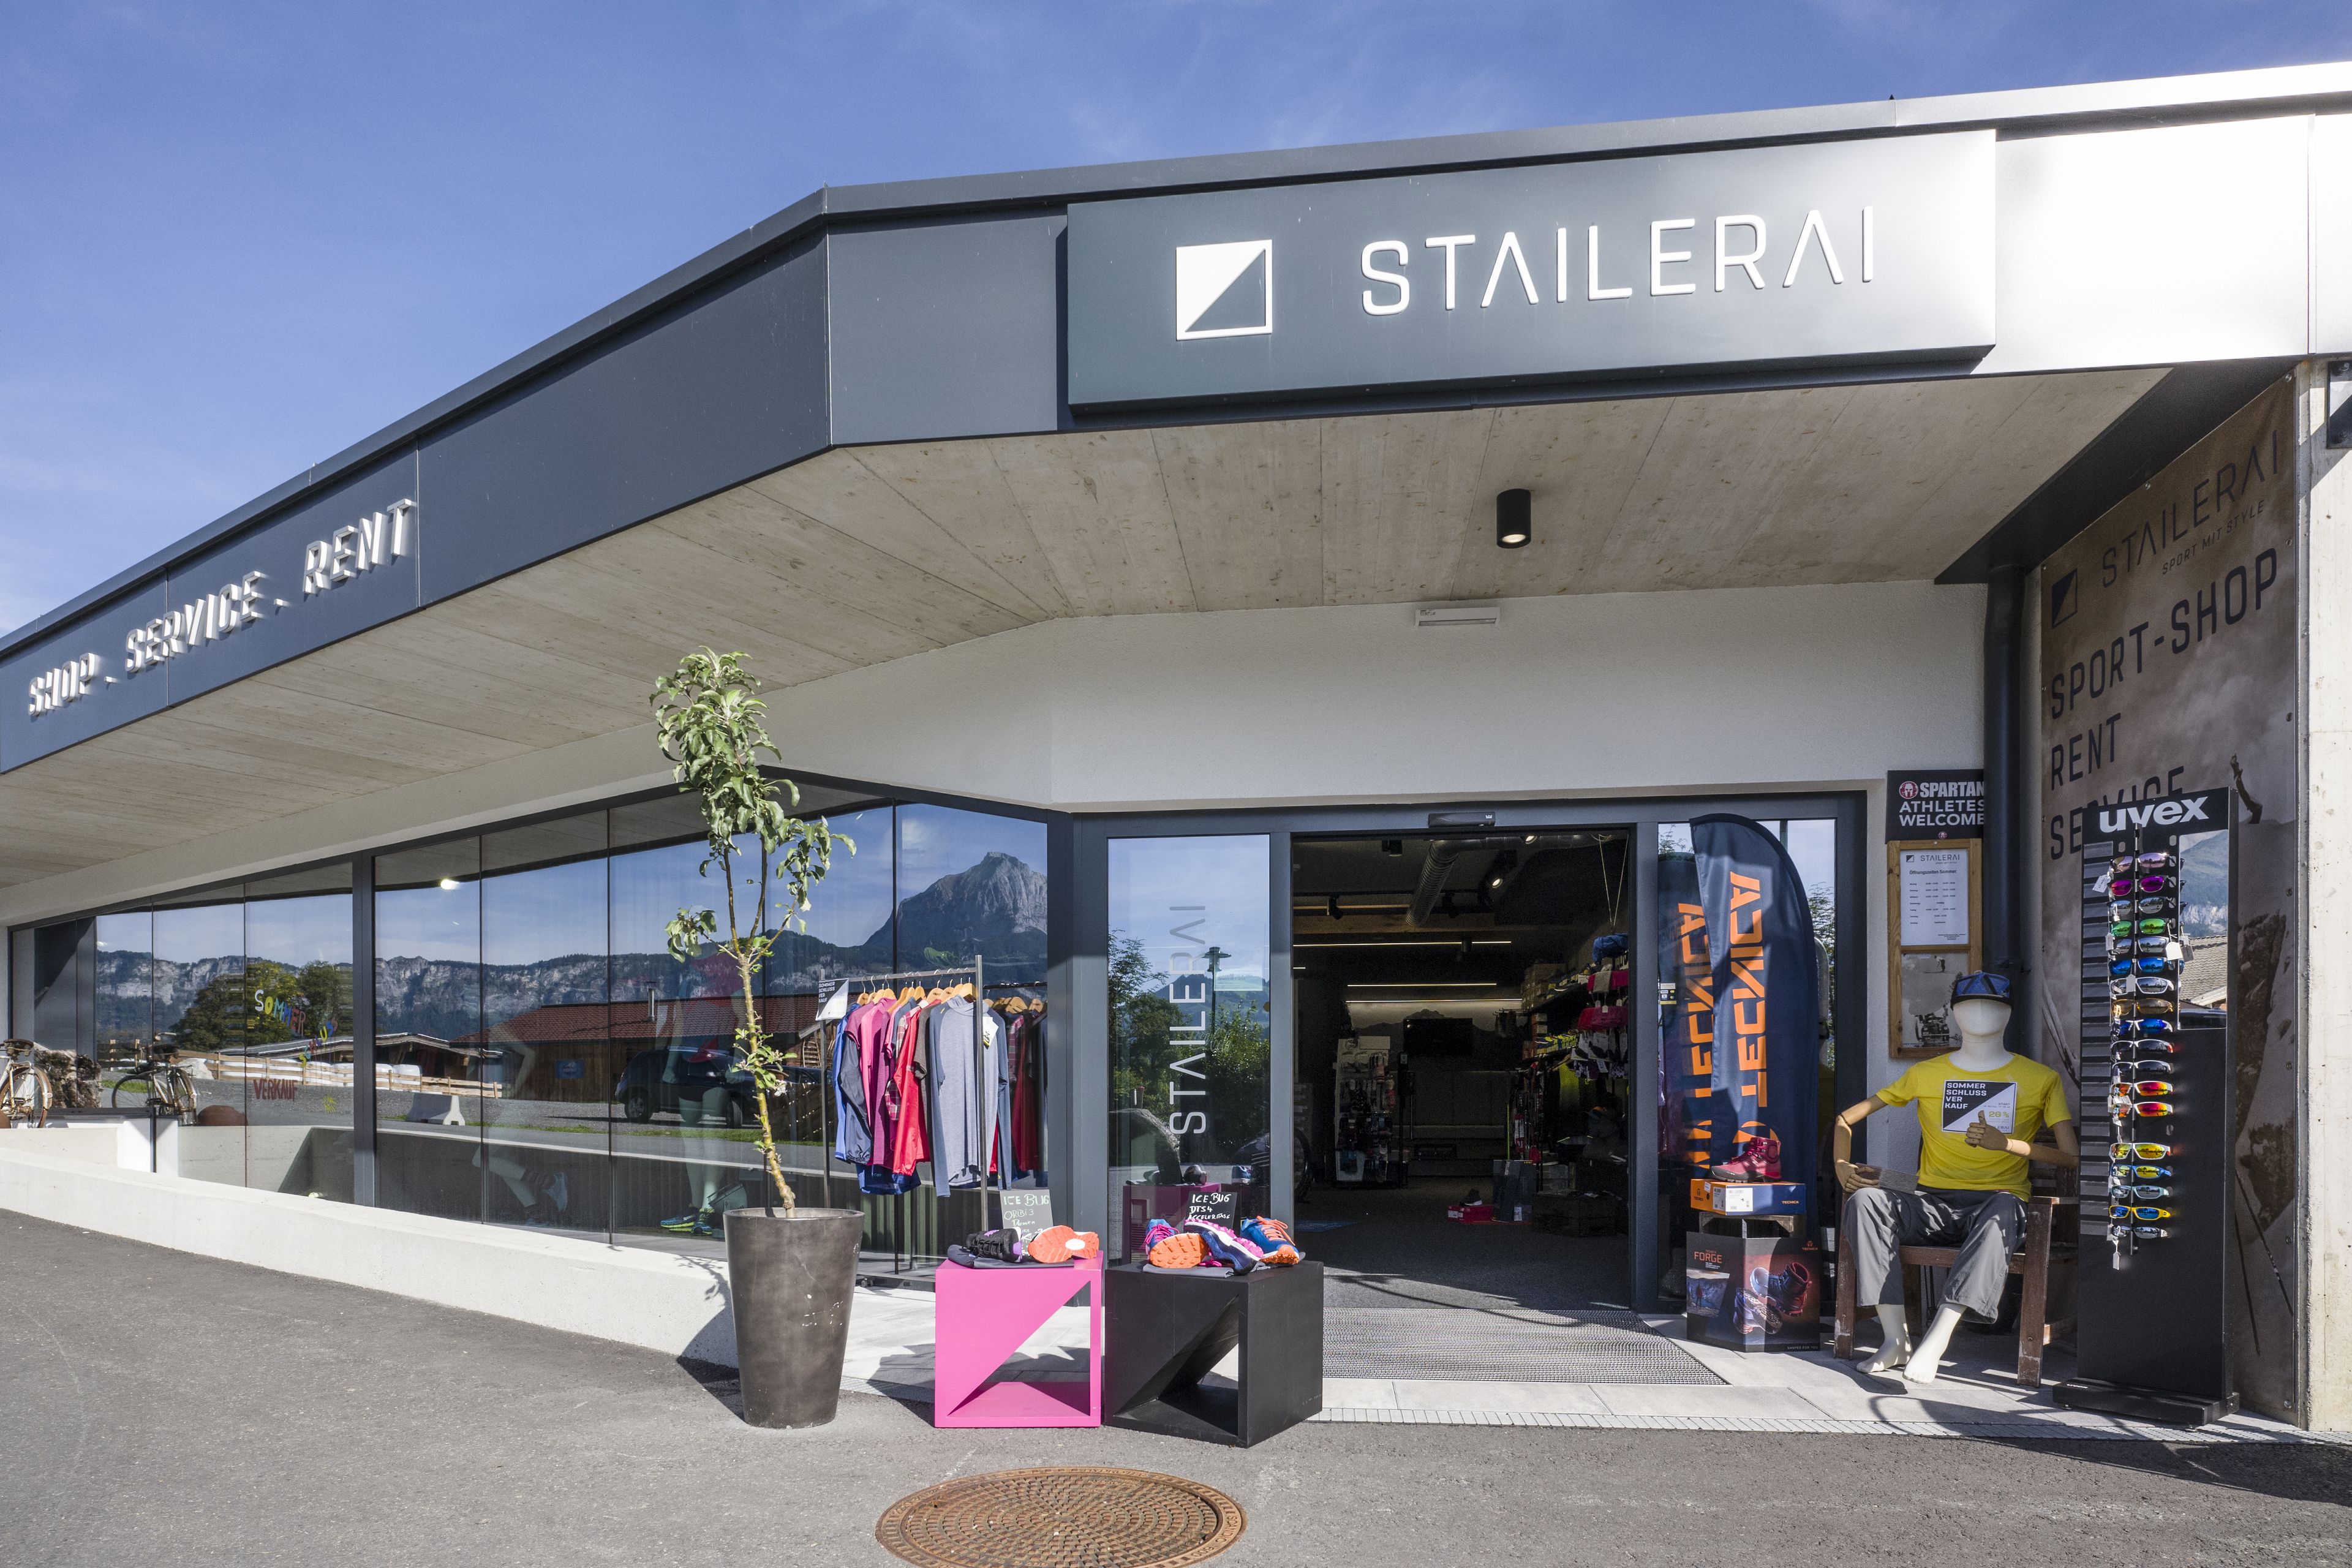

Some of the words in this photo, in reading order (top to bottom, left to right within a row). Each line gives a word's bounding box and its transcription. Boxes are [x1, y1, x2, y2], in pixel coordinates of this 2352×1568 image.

[1360, 206, 1874, 316] STAILERAI
[2102, 430, 2277, 588] STAILERAI
[2162, 543, 2196, 575] SPORT
[2202, 527, 2222, 550] MIT
[2226, 499, 2264, 533] STYLE
[29, 652, 97, 716] SHOP
[125, 571, 263, 673] SERVICE
[303, 498, 415, 594] RENT
[2051, 548, 2277, 720] SPORT-SHOP
[2051, 712, 2121, 791] RENT
[1899, 799, 1984, 813] ATHLETES
[1920, 781, 1984, 798] SPARTAN
[1899, 813, 1984, 826] WELCOME
[2100, 796, 2209, 833] uvex
[255, 989, 306, 1037] SOMMER
[1169, 906, 1205, 1134] STAILERAI
[253, 1079, 298, 1102] VERKAUF
[1003, 1196, 1021, 1205] ICE
[1024, 1193, 1049, 1206] BUG
[1192, 1194, 1208, 1204] ICE
[1209, 1193, 1232, 1204] BUG
[1694, 1251, 1722, 1264] FORGE
